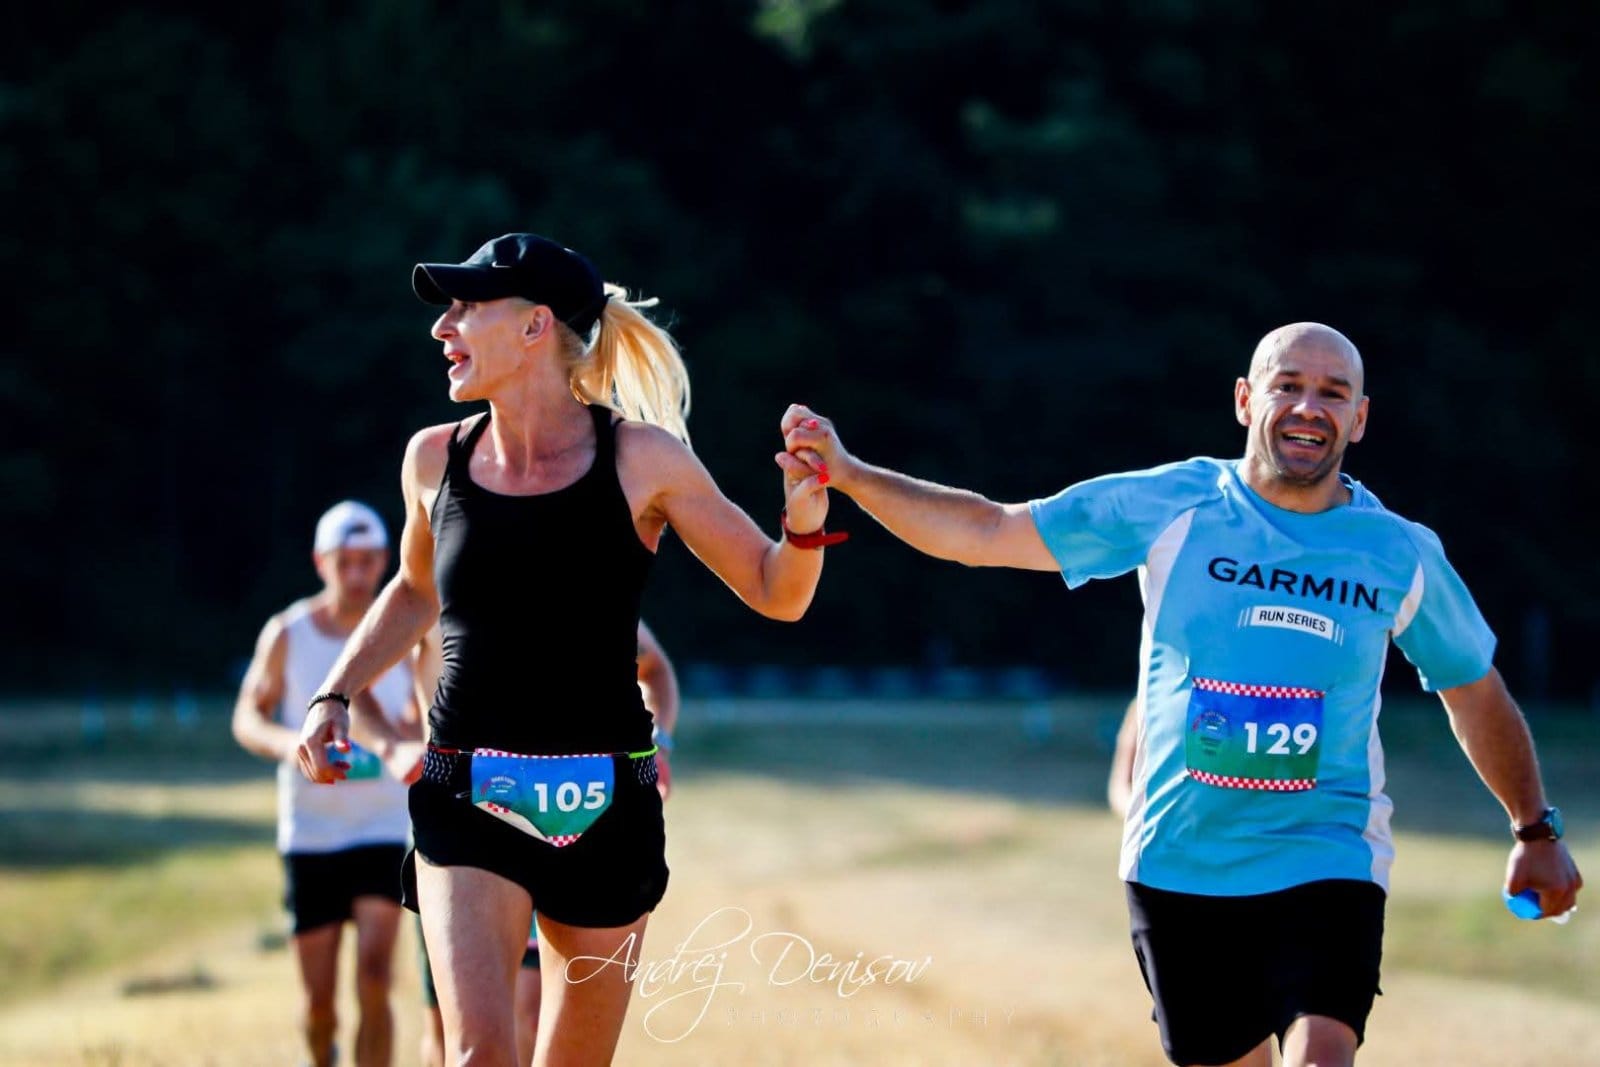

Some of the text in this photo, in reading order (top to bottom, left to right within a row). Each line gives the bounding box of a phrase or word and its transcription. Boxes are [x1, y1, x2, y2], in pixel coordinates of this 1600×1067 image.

[1207, 557, 1381, 612] GARMIN
[1259, 609, 1327, 633] RUN SERIES
[1244, 721, 1318, 755] 129
[534, 781, 606, 813] 105
